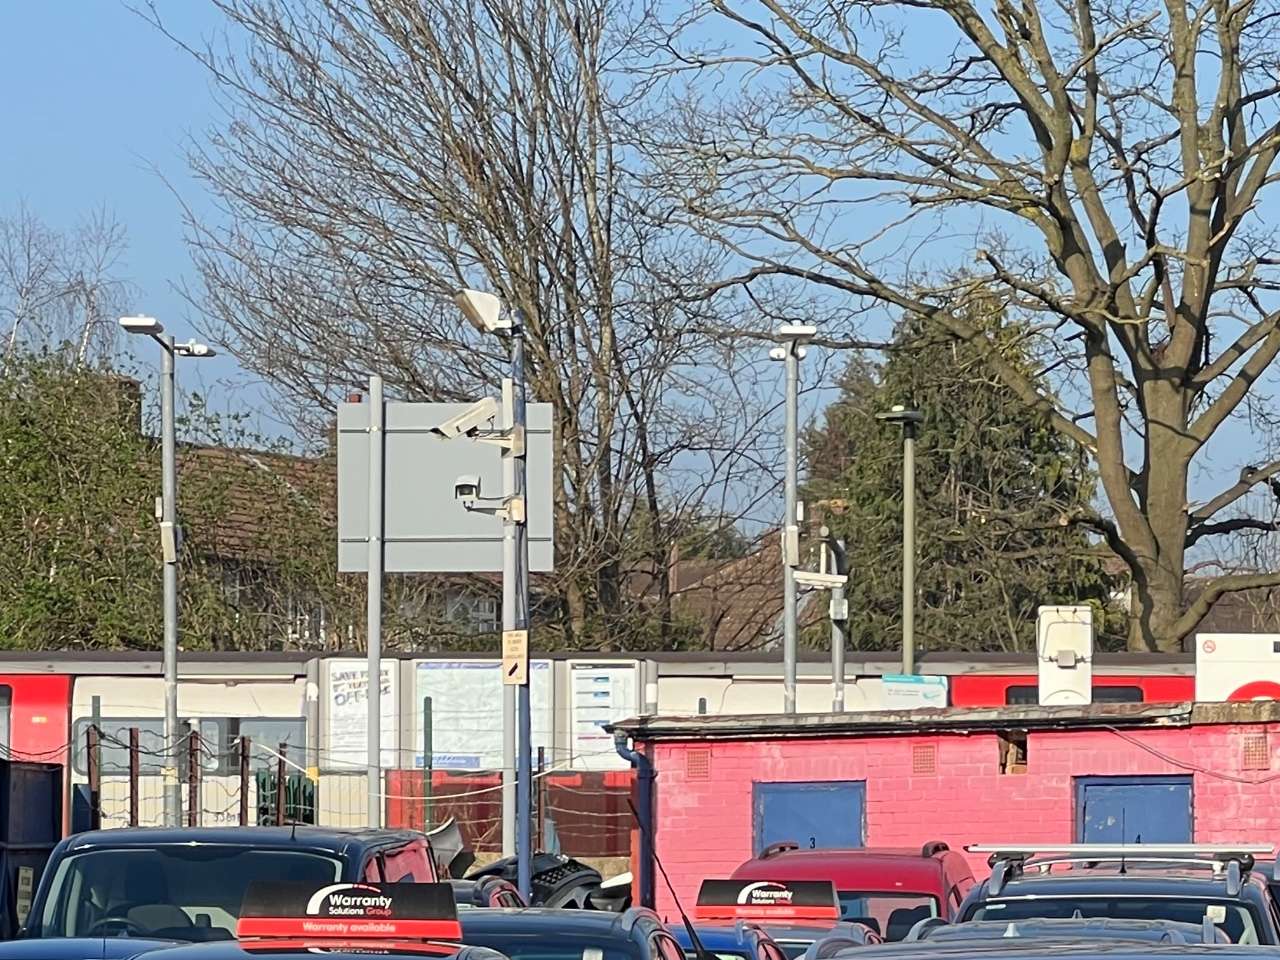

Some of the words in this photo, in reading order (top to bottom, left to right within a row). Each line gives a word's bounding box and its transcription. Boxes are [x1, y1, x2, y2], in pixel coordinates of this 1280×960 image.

[809, 837, 816, 849] 3
[752, 889, 792, 900] Warranty
[329, 894, 392, 910] Warranty
[328, 906, 364, 915] Solutions
[365, 906, 392, 916] Group
[303, 921, 348, 934] Warranty
[349, 921, 396, 932] available
